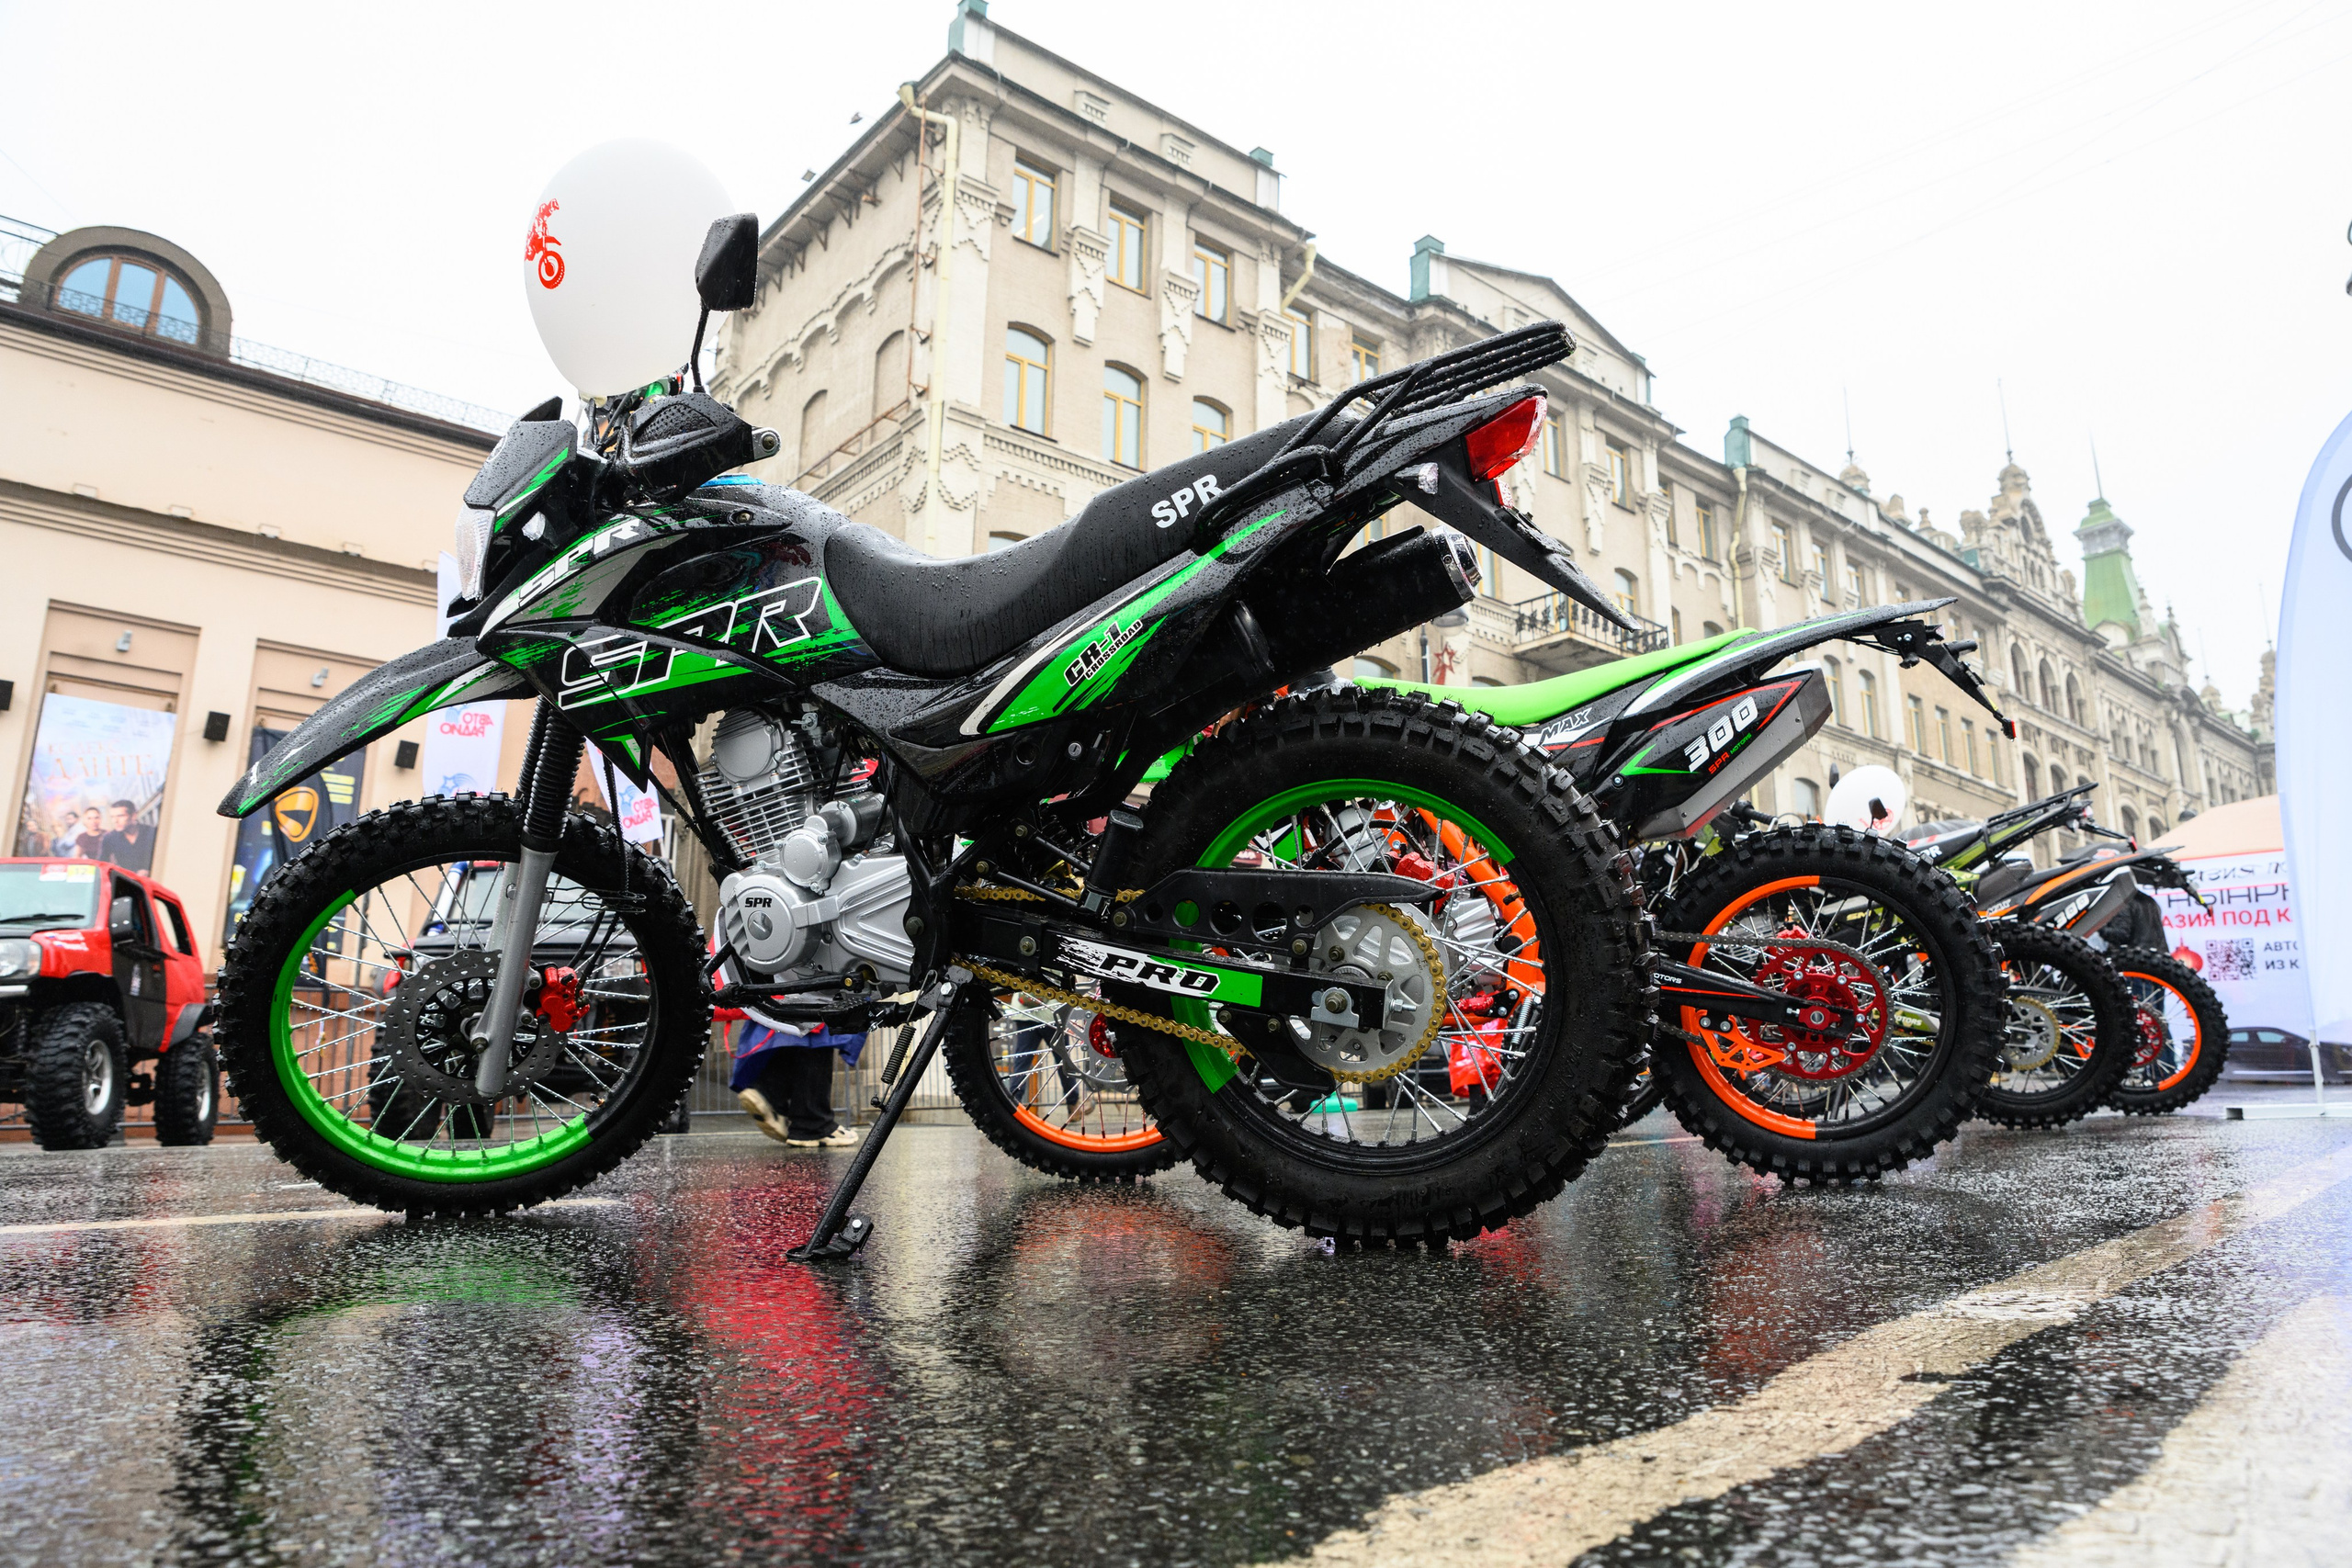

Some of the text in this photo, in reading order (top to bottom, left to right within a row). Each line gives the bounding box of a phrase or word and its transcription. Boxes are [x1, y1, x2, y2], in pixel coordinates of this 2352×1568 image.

[1151, 474, 1223, 528] SPR
[559, 577, 822, 710] SPR
[1064, 621, 1122, 686] CR-1
[1084, 620, 1143, 680] CROSSROAD
[1536, 707, 1592, 748] MAX
[1684, 696, 1758, 773] 300
[1709, 733, 1752, 774] SPR MOTORS
[745, 897, 772, 908] SPR
[2162, 911, 2216, 929] АЗИЯ
[2222, 908, 2271, 928] ПОД
[1099, 953, 1218, 993] PRO
[1654, 973, 1682, 984] OTORS
[2265, 960, 2285, 970] ИЗ
